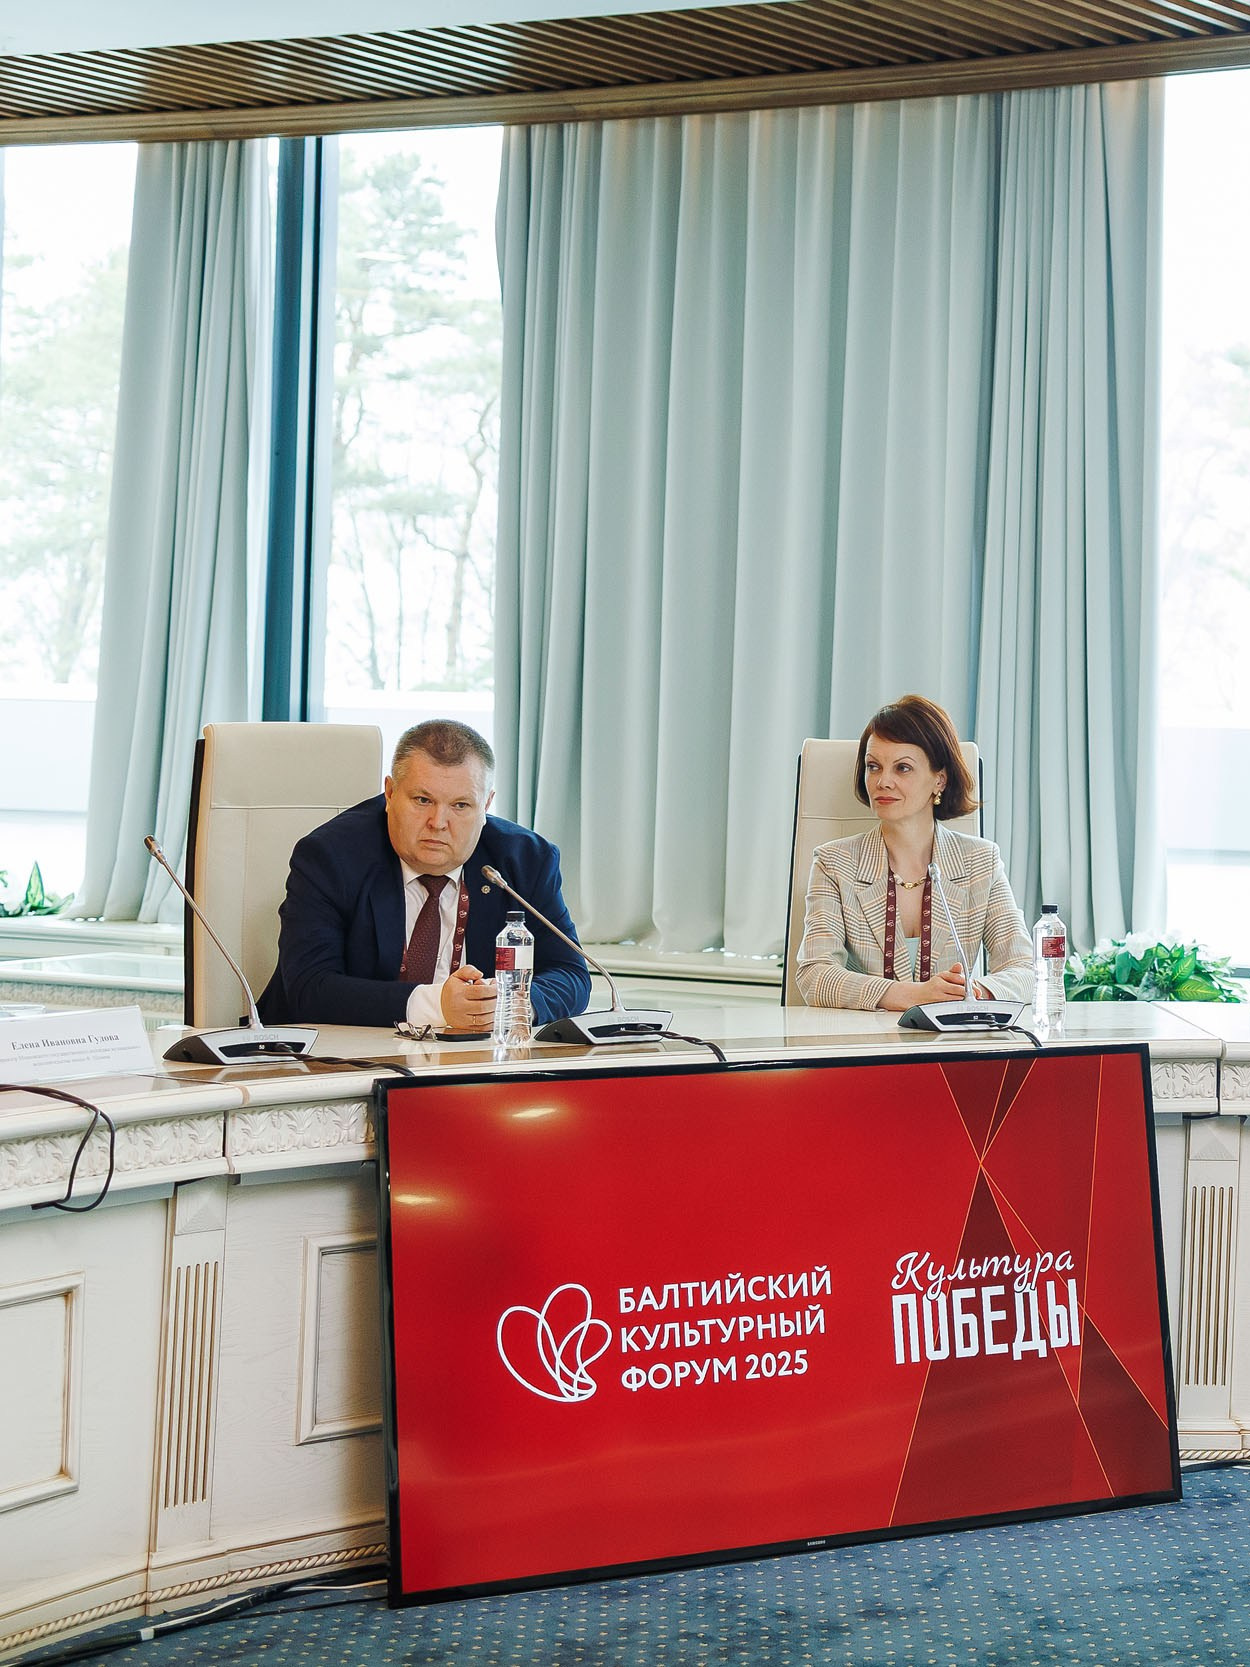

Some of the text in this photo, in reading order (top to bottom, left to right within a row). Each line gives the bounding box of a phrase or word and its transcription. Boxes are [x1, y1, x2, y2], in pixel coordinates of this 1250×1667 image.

[11, 1041, 41, 1050] Елена
[41, 1038, 87, 1048] Ивановна
[619, 1265, 832, 1314] БАЛТИЙСКИЙ
[891, 1250, 1075, 1301] Культура
[620, 1304, 826, 1353] КУЛЬТУРНЫЙ
[891, 1278, 1081, 1365] ПОБЕДЫ
[621, 1349, 808, 1392] ФОРУМ 2025
